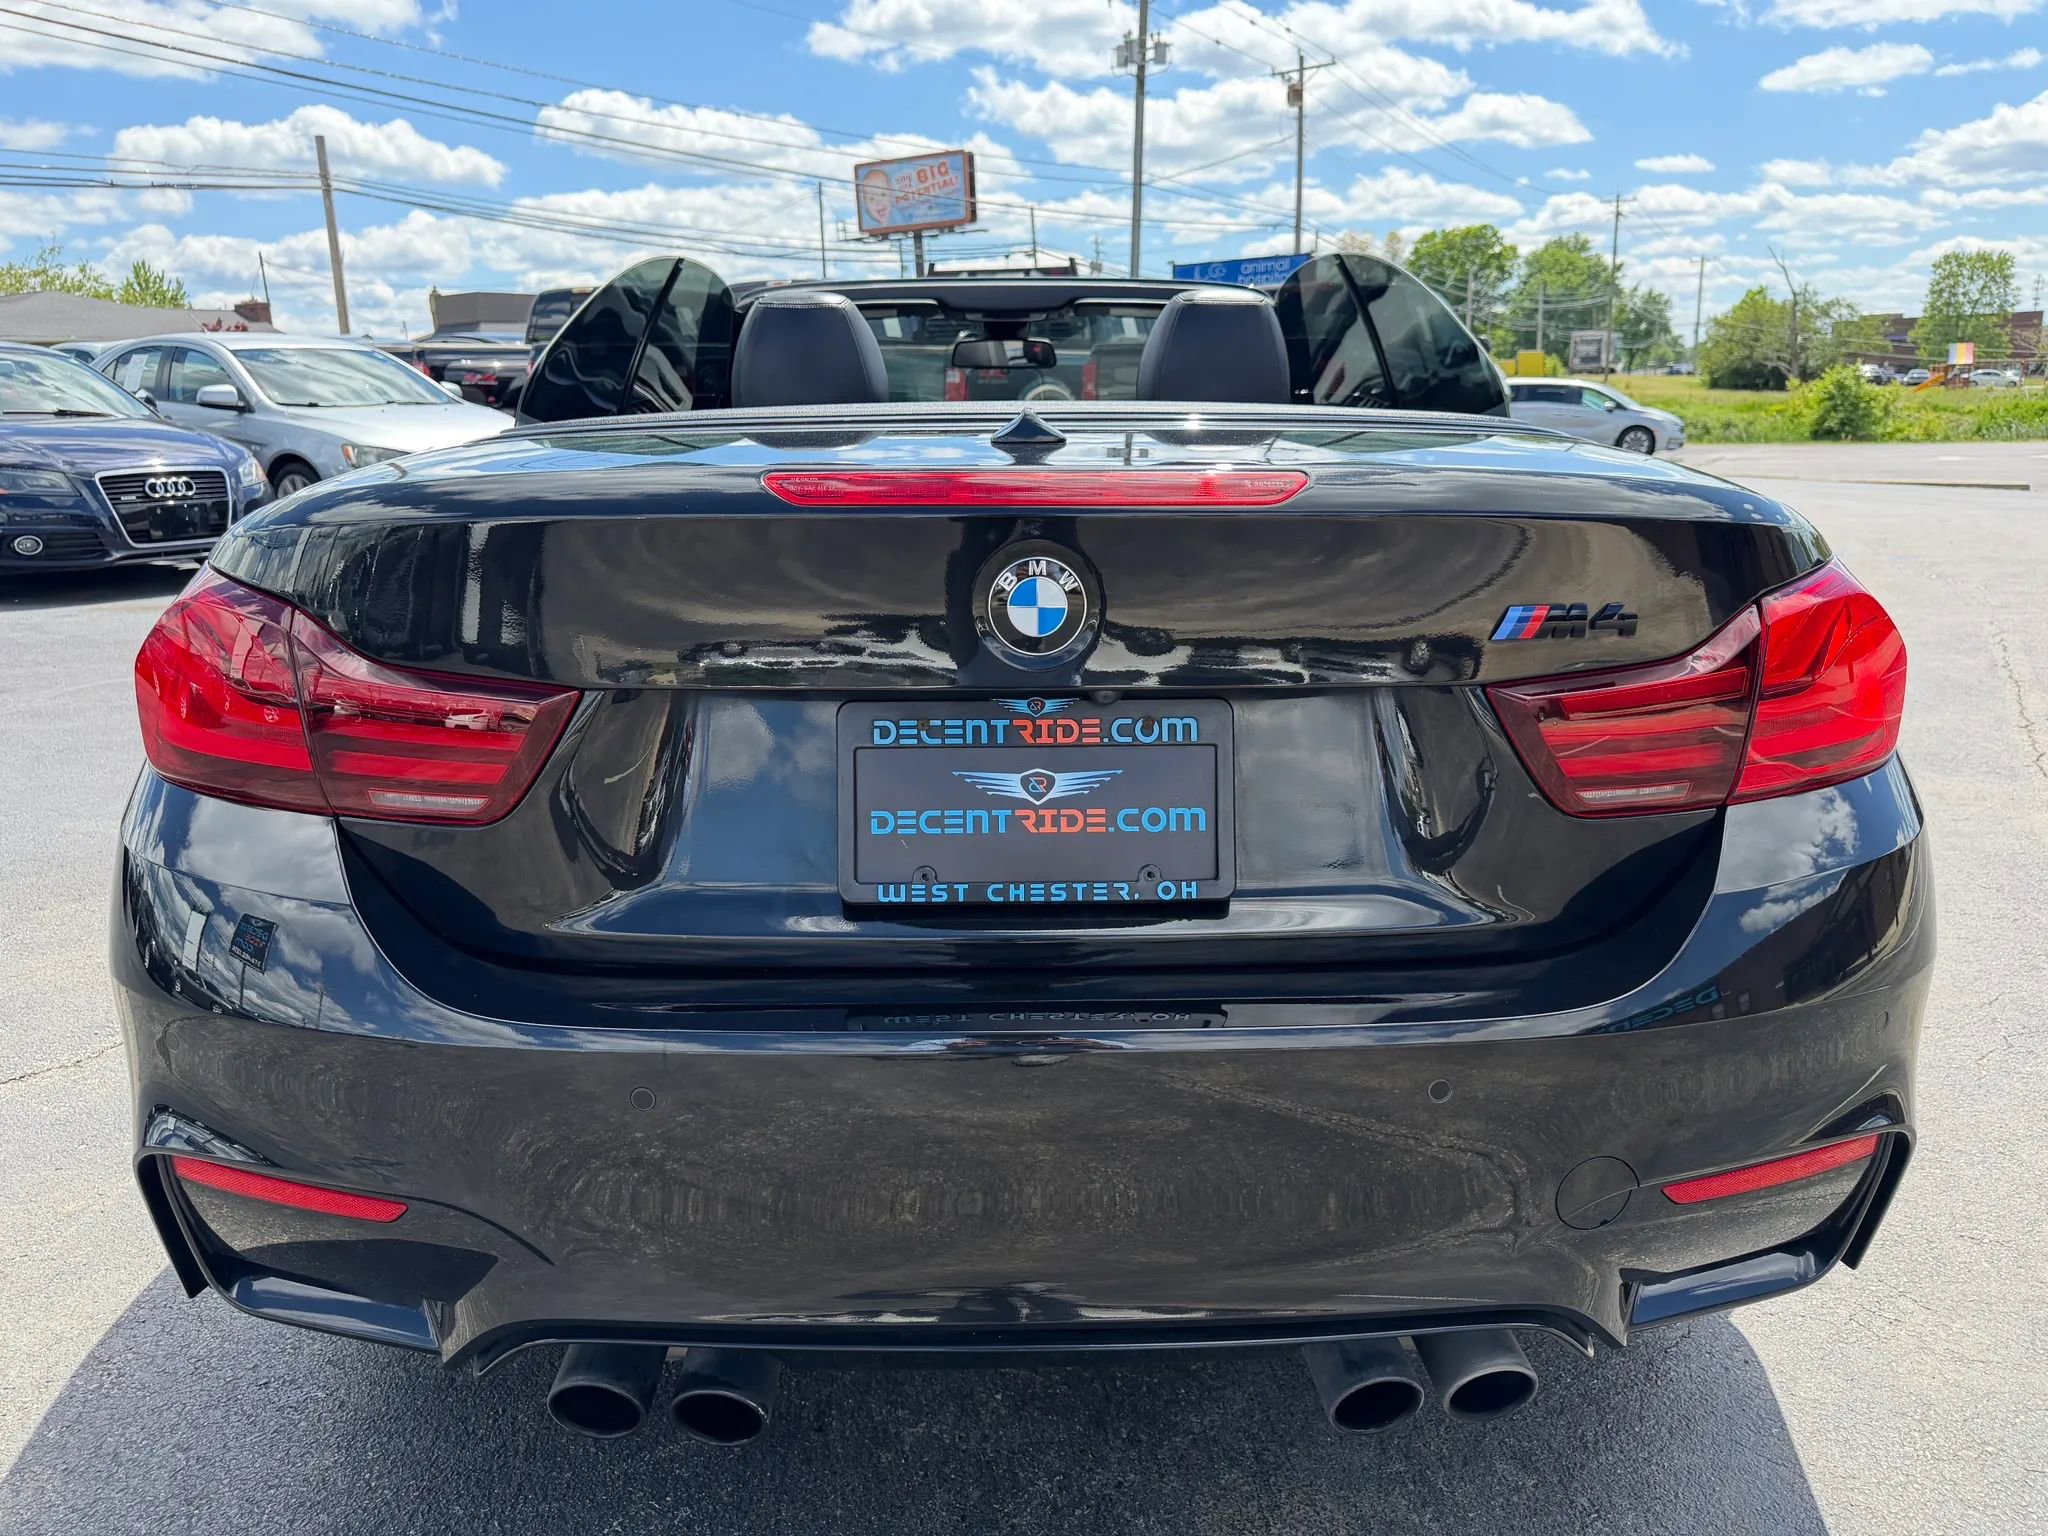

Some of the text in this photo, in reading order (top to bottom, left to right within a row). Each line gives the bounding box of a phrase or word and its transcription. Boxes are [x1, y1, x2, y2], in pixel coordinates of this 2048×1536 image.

[917, 161, 949, 183] BIG
[1240, 257, 1290, 275] animal
[998, 560, 1079, 591] BMW
[1528, 602, 1639, 638] M4
[877, 881, 1198, 902] WEST CHESTER, OH
